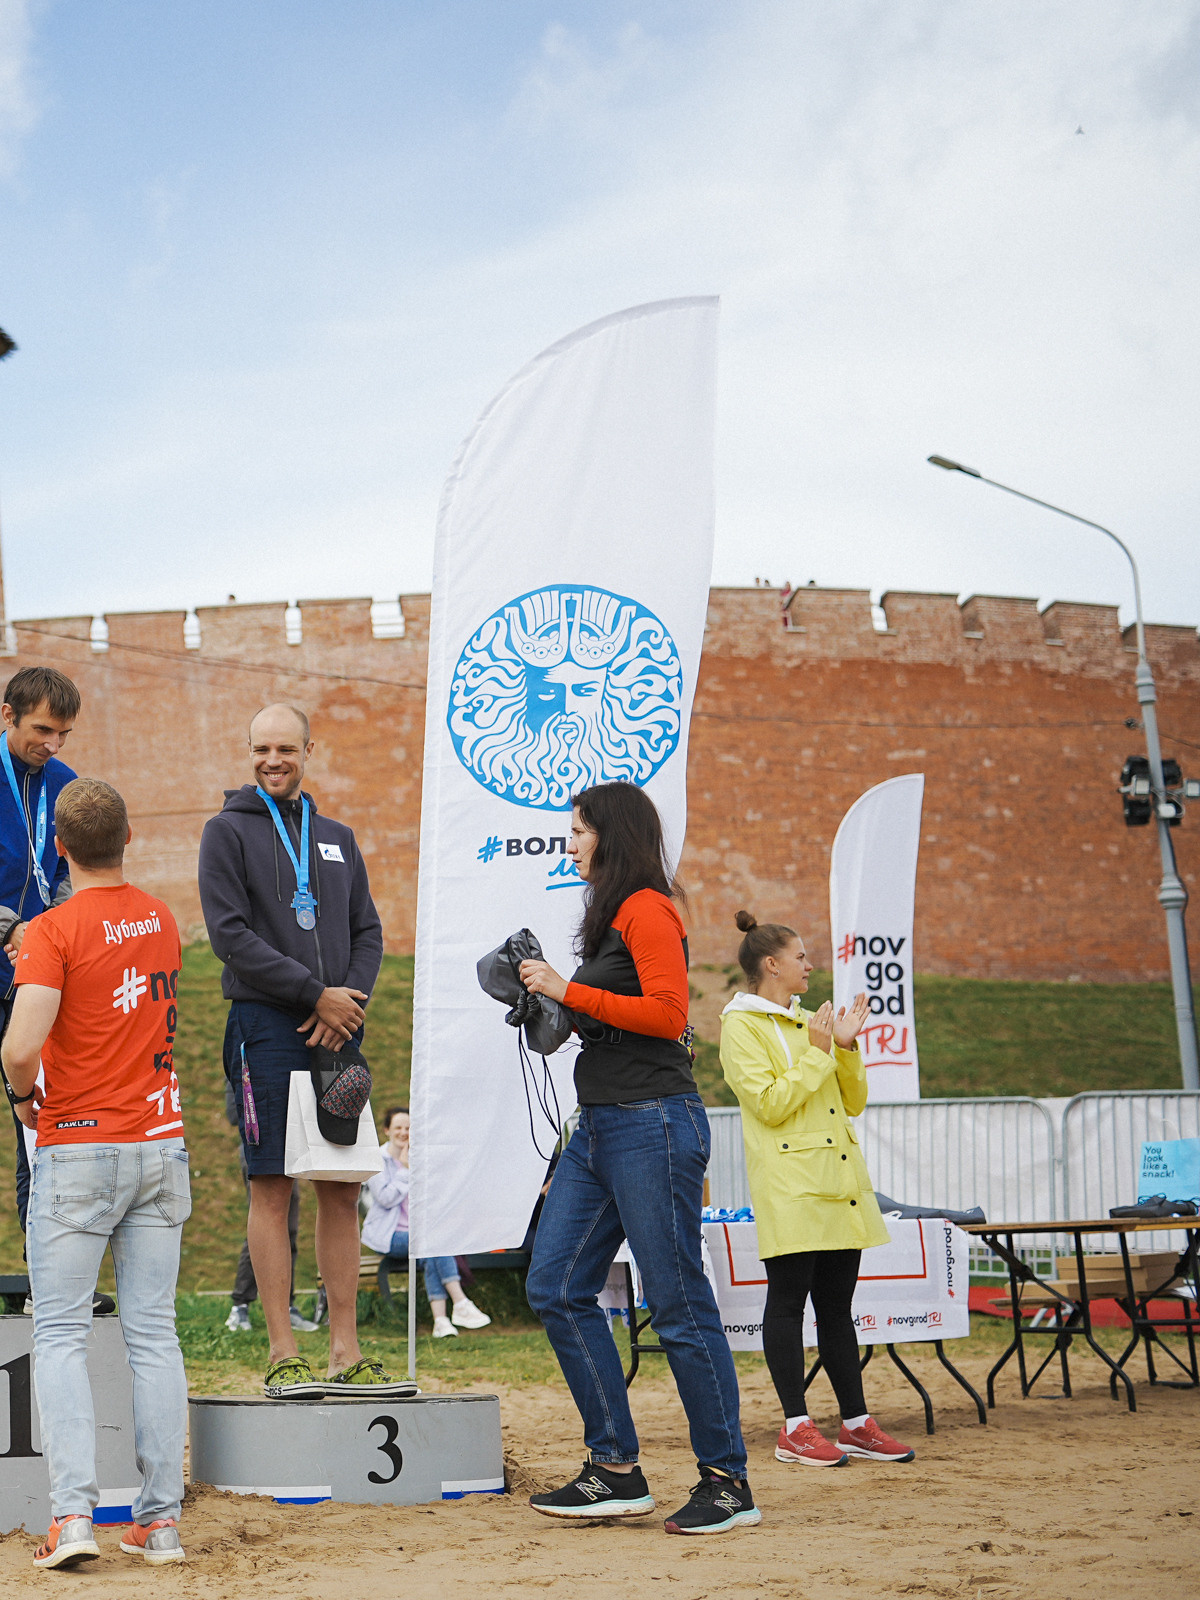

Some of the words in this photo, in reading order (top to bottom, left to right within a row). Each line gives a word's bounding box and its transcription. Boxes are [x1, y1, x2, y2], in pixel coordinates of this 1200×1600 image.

[477, 836, 573, 863] #ВОЛ
[102, 911, 162, 944] Дубовой
[838, 933, 907, 964] #nov
[865, 961, 904, 991] go
[860, 984, 905, 1015] od
[857, 1023, 908, 1054] TRI
[1143, 1154, 1163, 1163] look
[1145, 1146, 1162, 1155] You
[1141, 1170, 1175, 1179] snack!
[1142, 1162, 1160, 1170] like
[367, 1415, 403, 1484] 3
[575, 1475, 613, 1501] N
